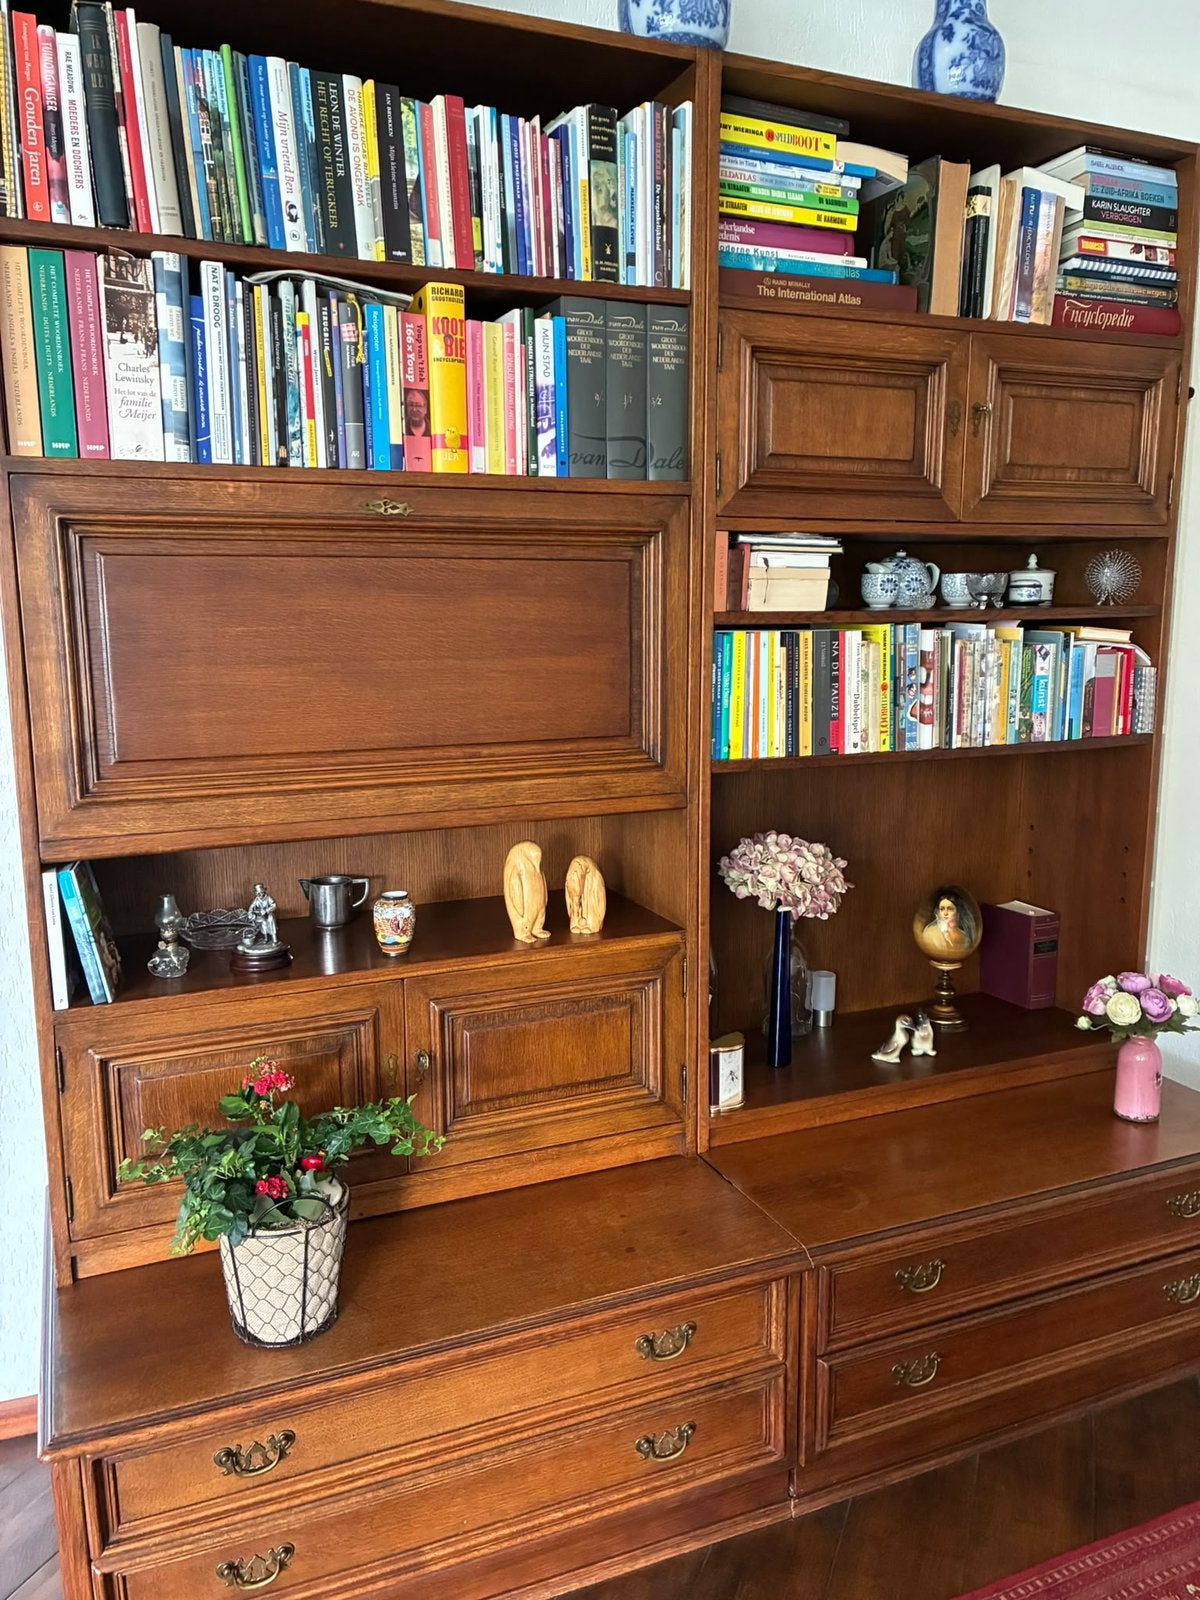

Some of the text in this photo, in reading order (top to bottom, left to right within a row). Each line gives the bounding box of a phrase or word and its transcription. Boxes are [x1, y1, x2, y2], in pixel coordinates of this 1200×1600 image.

[41, 42, 58, 112] TUINORGANISER
[64, 51, 75, 94] RAE MEADOWS
[24, 88, 42, 186] Gouden jaren
[276, 110, 288, 136] Mijn
[328, 82, 345, 177] LEON DE WINTER
[386, 106, 394, 137] BROKKEN
[68, 100, 84, 189] MOEDERS EN DOCHTERS
[316, 80, 338, 228] HET RECHT OP TERUGKEER
[347, 88, 364, 207] DE AVOND IS ONGEMAK
[356, 91, 372, 208] MARIEKE LUCAS RIJNEVELD
[733, 125, 764, 137] WIERINGA
[774, 131, 822, 152] SPEEDBOOT
[280, 139, 292, 174] vriend
[284, 175, 295, 194] Ben
[388, 144, 399, 210] Mijn kleine waanzin
[1091, 200, 1152, 217] KARIN SLAUGHTER
[1100, 185, 1140, 200] ZUID-AFRIKA
[1140, 190, 1165, 204] BOEKEN
[654, 195, 662, 251] vergankelijkheid
[725, 200, 748, 212] STRAATEN
[823, 214, 847, 226] HARMONIE
[1100, 210, 1142, 224] VERBORGEN
[720, 244, 779, 258] oderne Kunst
[4, 261, 13, 308] NEDERLANDS
[38, 264, 48, 311] NEDERLANDS
[210, 266, 219, 284] NAT
[771, 279, 786, 288] RAND
[50, 281, 59, 318] COMPLETE
[74, 268, 83, 315] NEDERLANDS
[431, 286, 464, 298] RICHARD
[756, 284, 862, 306] The International Atlas
[8, 313, 16, 340] ENGELS
[14, 262, 29, 370] HET COMPLETE WOORDENBOEK
[42, 316, 50, 338] DUITS
[84, 268, 98, 376] HET COMPLETE WOORDENBOEK
[212, 295, 221, 328] DROOG
[432, 316, 464, 337] KOOT
[1062, 299, 1135, 330] Encyclopedie
[322, 306, 330, 352] TERUGBLIK
[371, 310, 380, 352] Reisgenoten
[406, 322, 415, 344] 166
[416, 324, 424, 344] Youp
[10, 347, 18, 375] ENGELS
[54, 320, 64, 373] WOORDENBOEK
[80, 348, 88, 371] FRANS
[444, 334, 464, 358] BIE
[115, 373, 155, 386] Lewinsky
[118, 362, 150, 373] Charles
[406, 353, 416, 382] Youp
[543, 355, 551, 377] STAD
[13, 380, 22, 426] NEDERLANDS
[47, 371, 57, 417] NEDERLANDS
[82, 376, 92, 422] NEDERLANDS
[114, 387, 126, 395] Het
[127, 388, 136, 396] lot
[149, 389, 156, 398] de
[118, 396, 153, 408] familie
[119, 408, 156, 422] Meijer
[568, 435, 684, 470] van Dale
[831, 641, 839, 718] NA DE PAUZE
[1037, 680, 1048, 708] kunst
[852, 693, 860, 734] Dubbelspel
